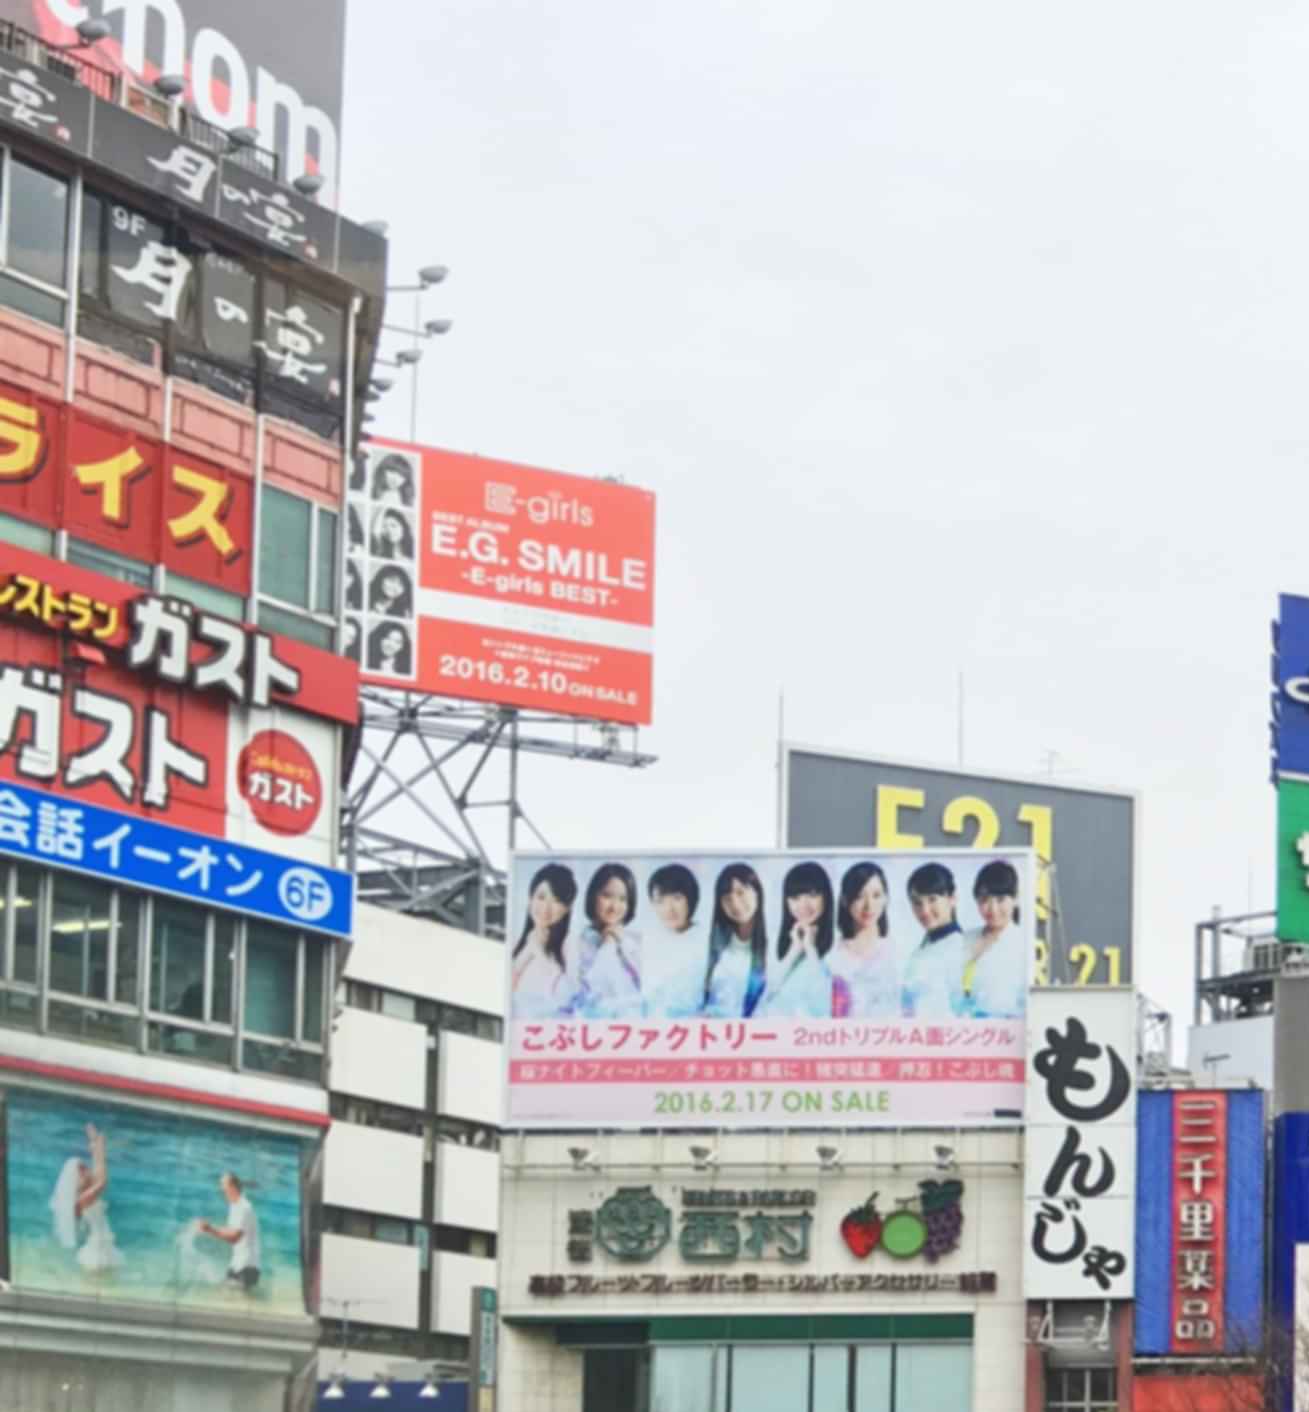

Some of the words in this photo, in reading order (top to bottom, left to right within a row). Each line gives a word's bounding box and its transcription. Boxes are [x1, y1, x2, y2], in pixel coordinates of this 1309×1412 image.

[112, 205, 148, 238] 9F
[432, 523, 509, 566] E.G.
[517, 538, 647, 590] SMILE
[131, 596, 299, 706] ガスト
[439, 654, 567, 693] 2016.2.10
[569, 682, 594, 699] ON
[596, 686, 638, 705] SALE
[0, 667, 206, 808] ガスト
[246, 770, 315, 811] ガスト
[285, 870, 329, 916] 6F
[522, 1023, 778, 1051] こぶしファクトリー
[654, 1090, 775, 1114] 2016.2.17
[781, 1090, 822, 1113] ON
[831, 1090, 890, 1113] SALE
[1032, 1016, 1131, 1293] もんじゃ
